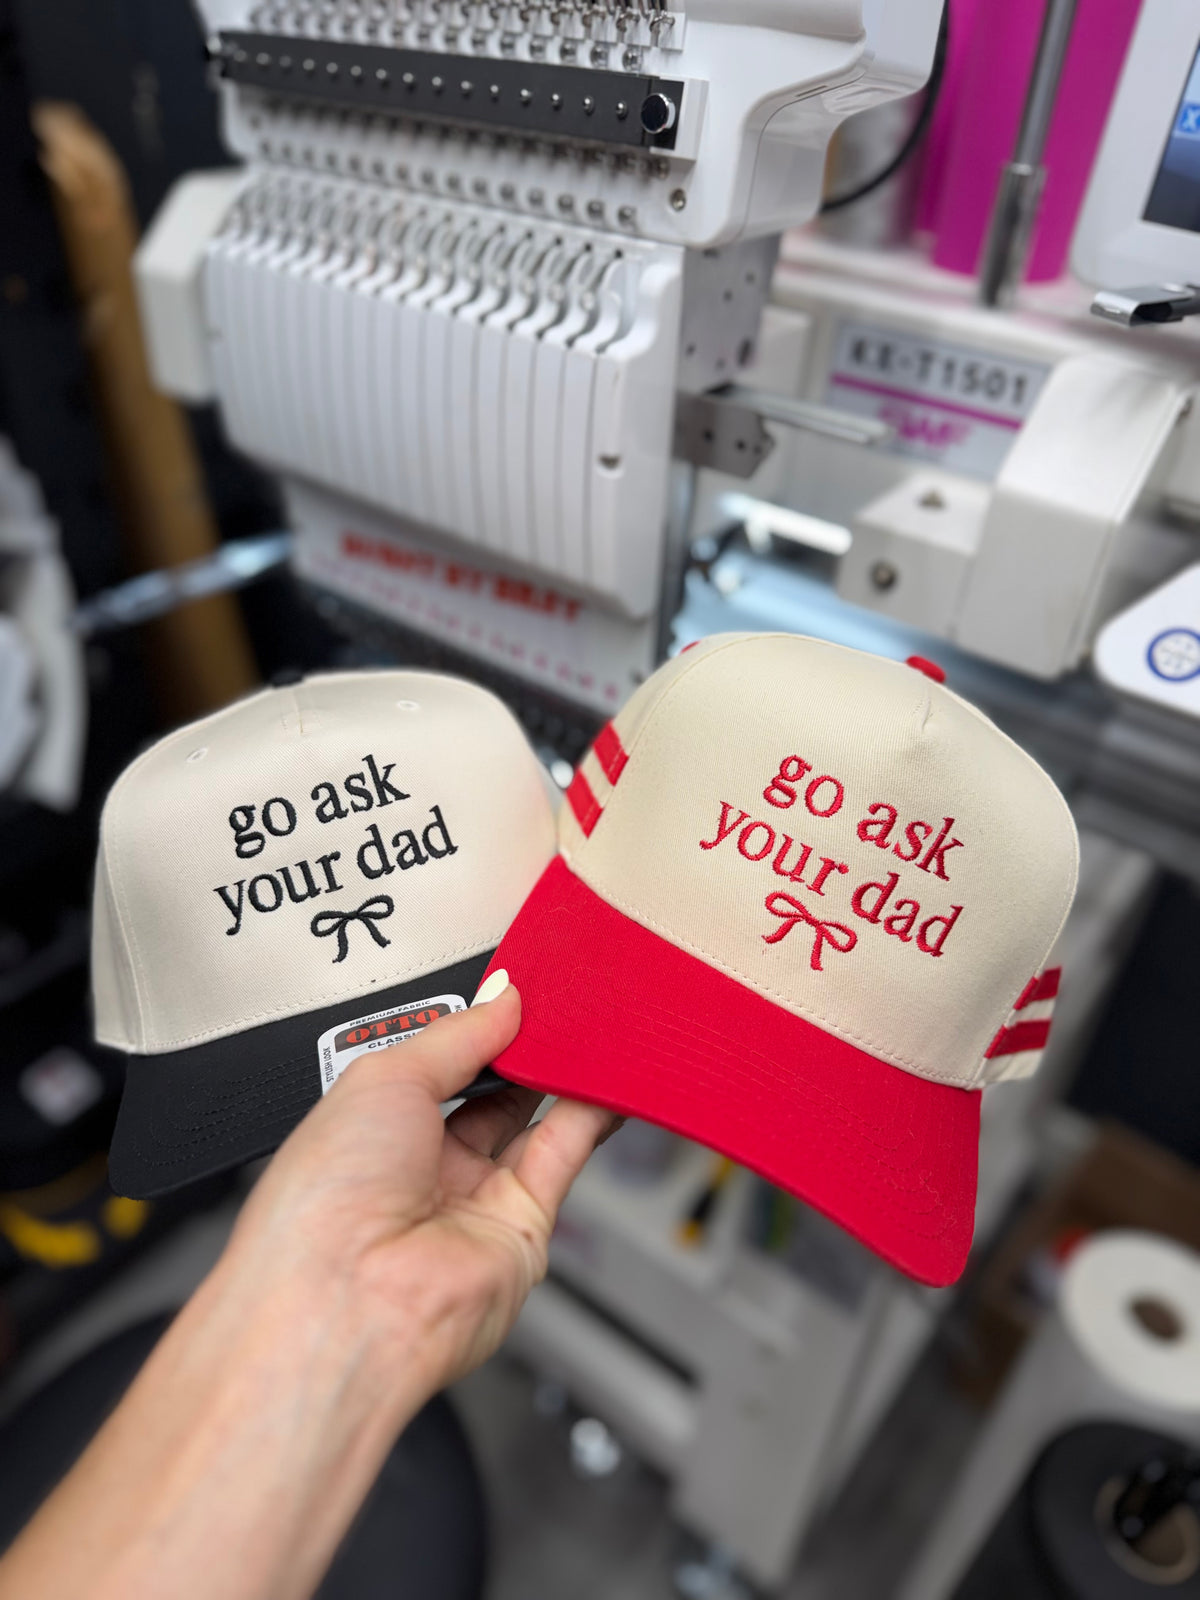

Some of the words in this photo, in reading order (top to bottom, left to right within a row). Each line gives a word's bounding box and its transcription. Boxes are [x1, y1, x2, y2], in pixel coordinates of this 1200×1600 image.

[229, 797, 297, 859] go
[310, 754, 411, 824] ask
[763, 754, 844, 818] go
[856, 802, 965, 882] ask
[213, 850, 342, 936] your
[356, 805, 459, 880] dad
[699, 800, 849, 896] your
[850, 871, 964, 957] dad
[346, 1009, 440, 1044] OTTO
[349, 1010, 395, 1027] PREMIUM
[398, 1000, 431, 1013] FABRIC
[368, 1031, 420, 1049] CLASSI
[324, 1061, 335, 1082] STYLISH
